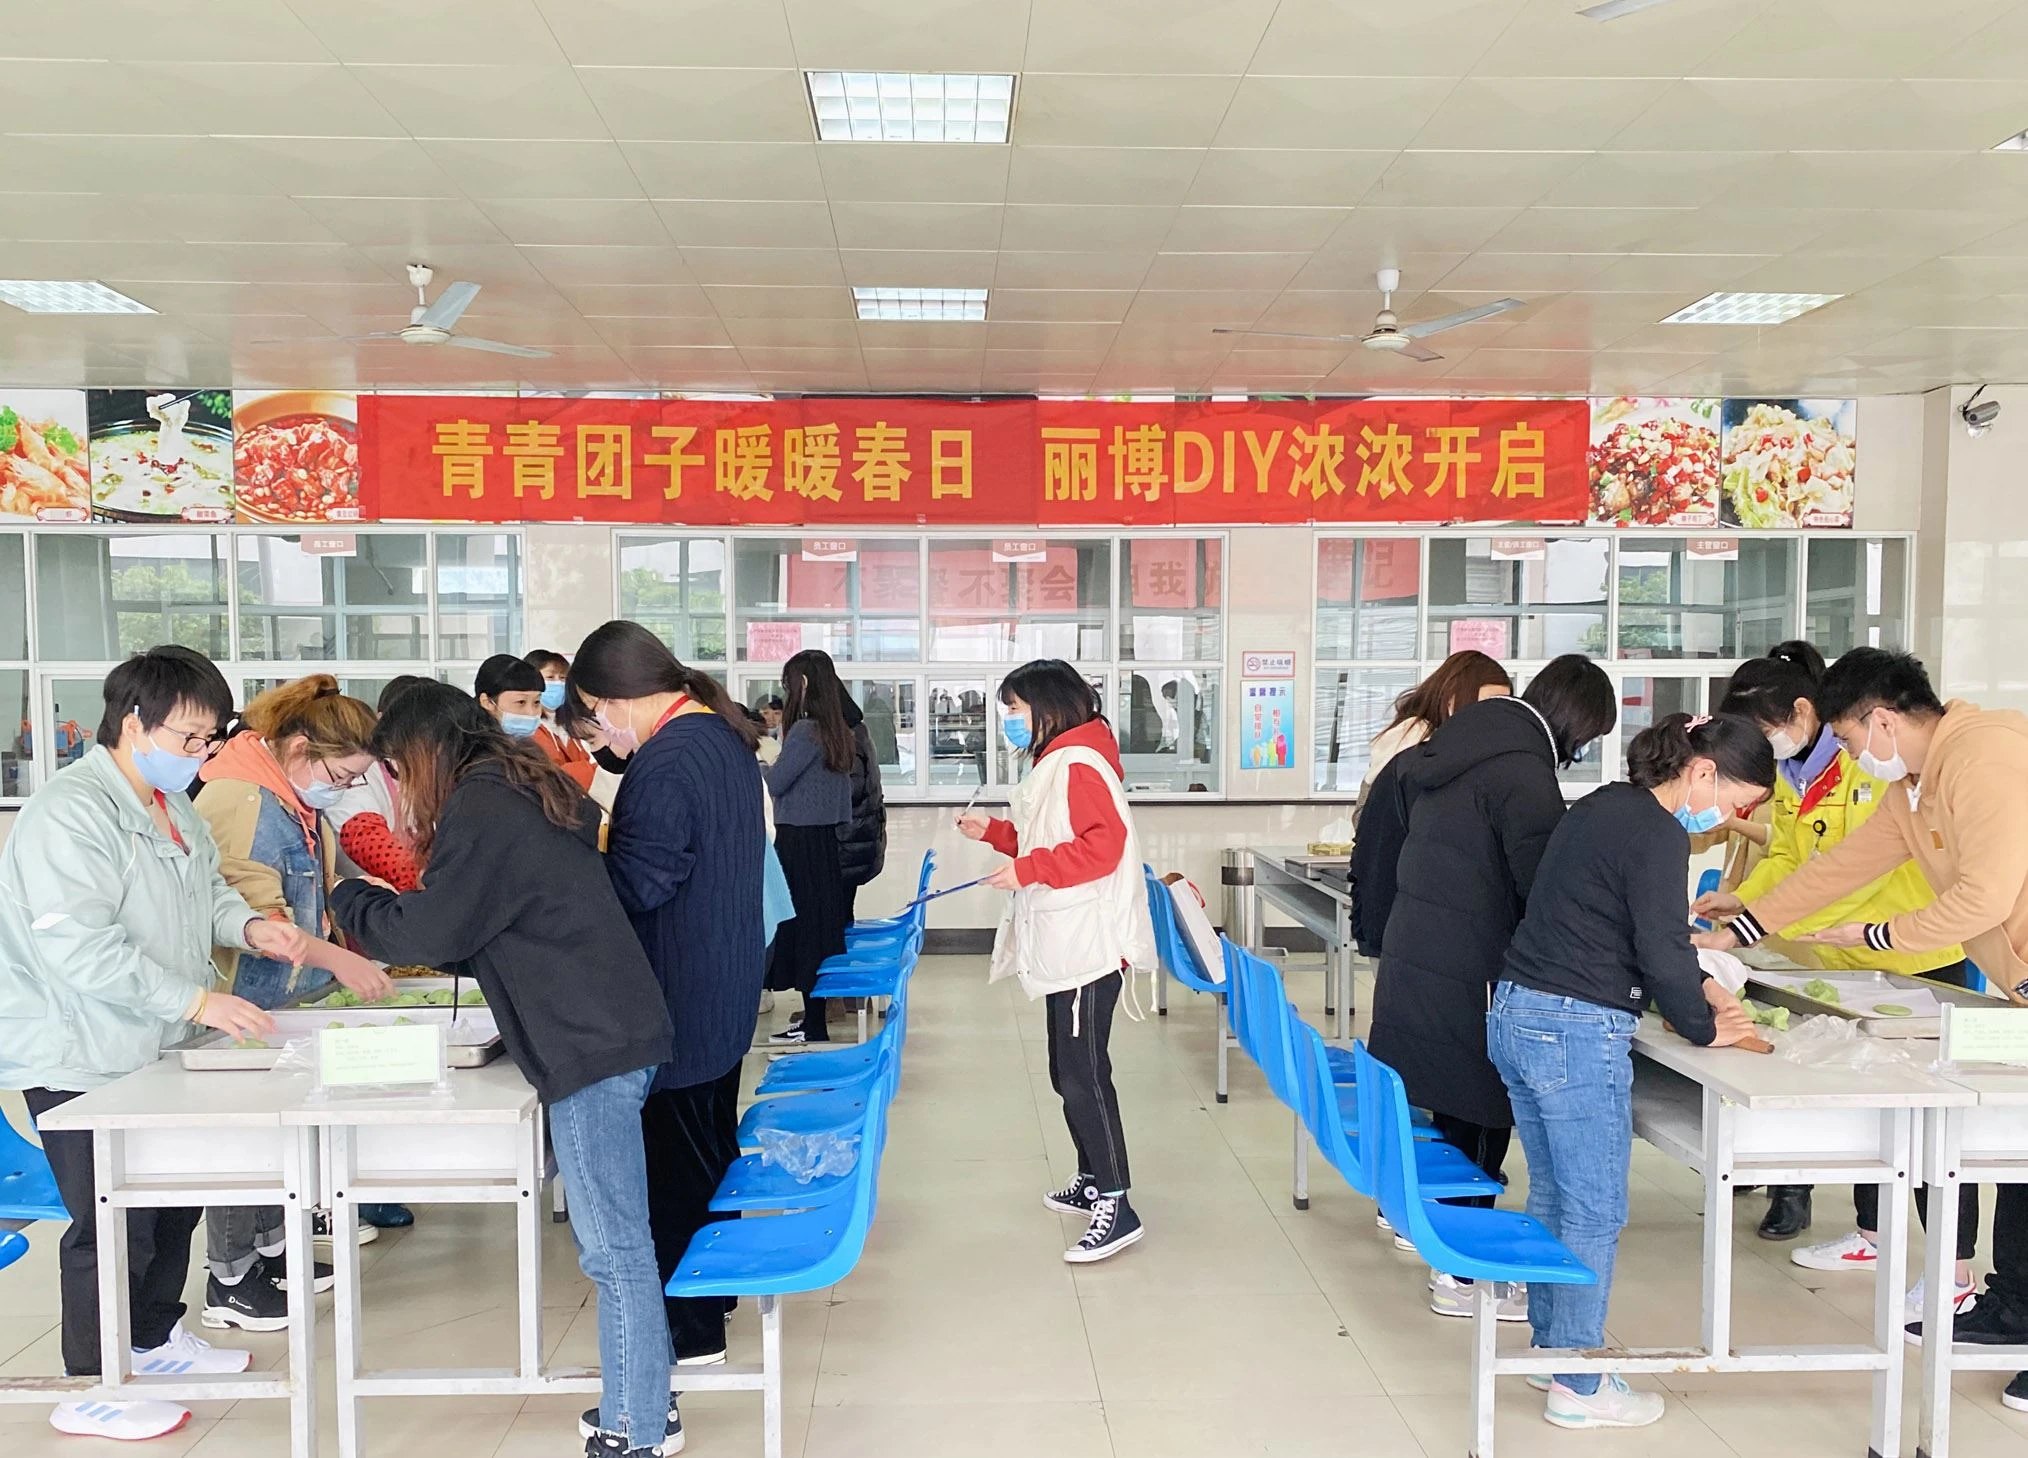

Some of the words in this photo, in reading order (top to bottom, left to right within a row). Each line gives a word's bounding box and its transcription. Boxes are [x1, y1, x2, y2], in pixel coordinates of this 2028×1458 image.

[432, 419, 973, 502] 青青团子暖暖春日
[1042, 421, 1546, 501] 丽博DIY浓浓开启
[813, 541, 846, 551] 员工窗口
[1004, 542, 1036, 551] 员工窗口
